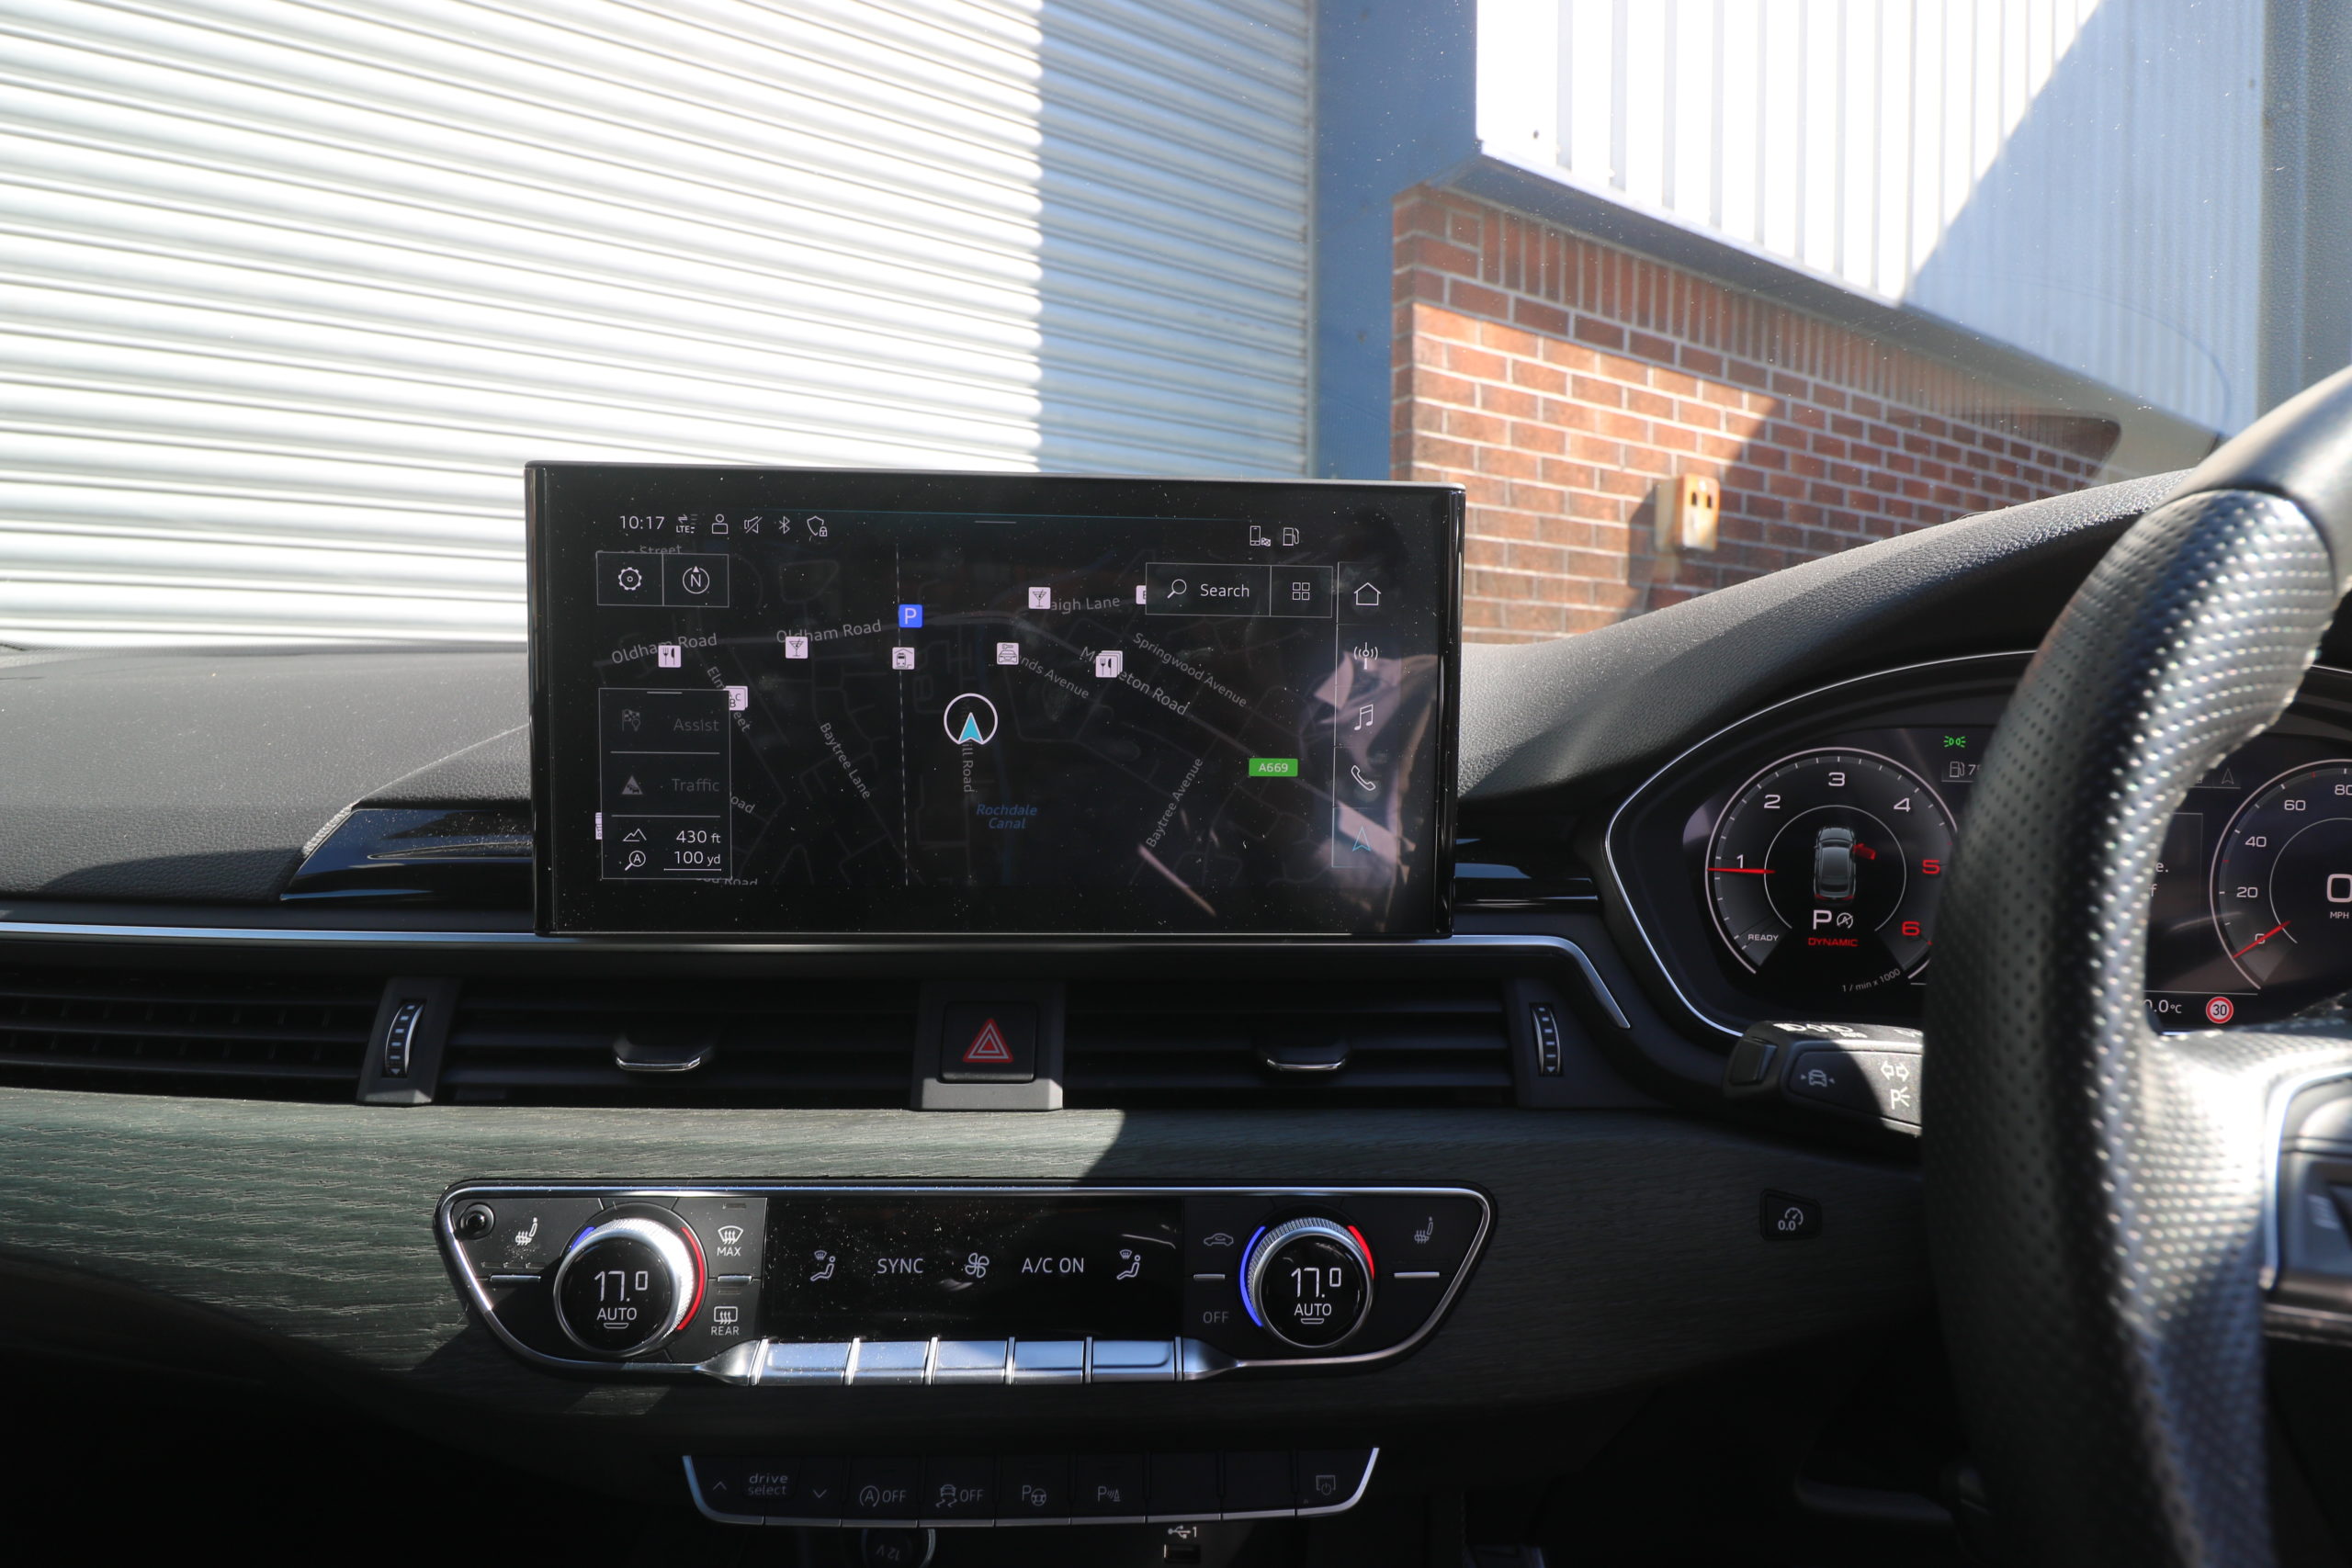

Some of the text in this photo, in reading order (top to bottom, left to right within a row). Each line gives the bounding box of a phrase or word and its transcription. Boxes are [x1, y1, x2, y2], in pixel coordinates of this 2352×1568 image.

[619, 515, 665, 530] 10:17
[675, 525, 690, 534] LTE
[1200, 582, 1250, 598] Search
[1086, 597, 1121, 611] Lane
[842, 618, 882, 637] Road
[677, 632, 718, 649] Road
[1133, 632, 1247, 707] Springwood Avenue
[1045, 670, 1090, 699] Avenue
[1152, 687, 1189, 716] Road
[673, 718, 719, 732] Assist
[820, 722, 870, 799] Baytree Lane
[1259, 763, 1288, 773] A669
[963, 760, 975, 793] Road
[1827, 772, 1846, 787] 3
[672, 778, 719, 792] Traffic
[730, 795, 755, 814] oad
[1146, 758, 1204, 849] Baytree Avenue
[1763, 795, 1781, 809] 2
[1893, 797, 1911, 812] 4
[2284, 800, 2306, 811] 60
[977, 804, 1037, 816] Rochdale
[989, 818, 1026, 829] Canal
[675, 830, 721, 843] 430 ft
[2245, 836, 2267, 847] 40
[674, 852, 721, 866] 100 yd
[1736, 854, 1745, 868] 1
[1922, 860, 1940, 874] 5
[2236, 886, 2258, 898] 20
[1813, 909, 1833, 930] P
[2330, 911, 2349, 919] MPH
[1901, 920, 1920, 936] 6
[1808, 938, 1858, 947] DYNAMIC
[1855, 980, 1871, 990] min
[1880, 968, 1901, 983] 1000
[2212, 1004, 2228, 1016] 30
[717, 1247, 741, 1257] MAX
[876, 1258, 924, 1274] SYNC
[1022, 1258, 1085, 1273] A/C ON
[597, 1307, 638, 1321] AUTO
[1294, 1303, 1332, 1316] AUTO
[1203, 1312, 1228, 1324] OFF
[710, 1326, 740, 1336] REAR
[749, 1472, 788, 1484] drive
[748, 1484, 787, 1495] select
[882, 1489, 907, 1503] OFF
[959, 1489, 984, 1503] OFF
